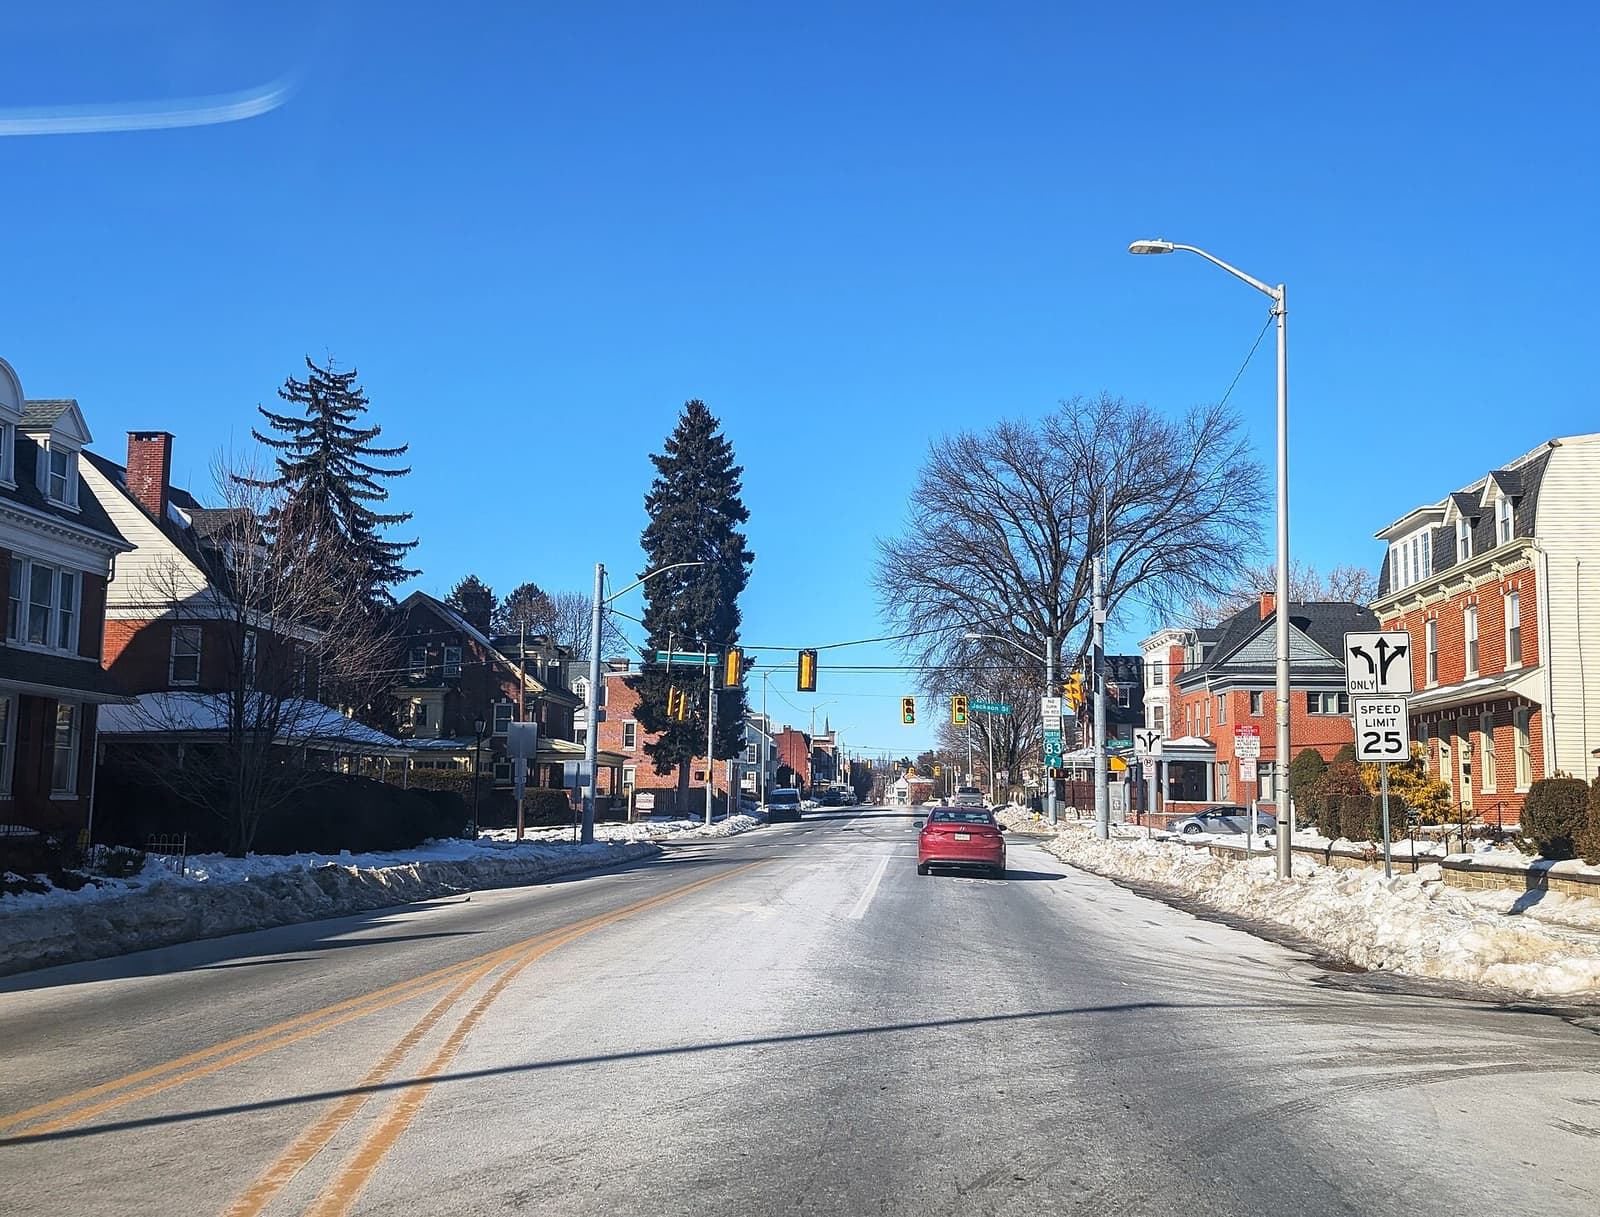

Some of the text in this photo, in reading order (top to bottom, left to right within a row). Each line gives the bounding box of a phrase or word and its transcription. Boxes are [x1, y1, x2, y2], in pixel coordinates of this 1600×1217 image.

[1350, 680, 1375, 690] ONLY
[971, 703, 999, 711] Jackson
[1360, 705, 1401, 714] SPEED
[1365, 718, 1396, 727] LIMIT
[1362, 731, 1403, 754] 25
[1046, 743, 1061, 754] 83
